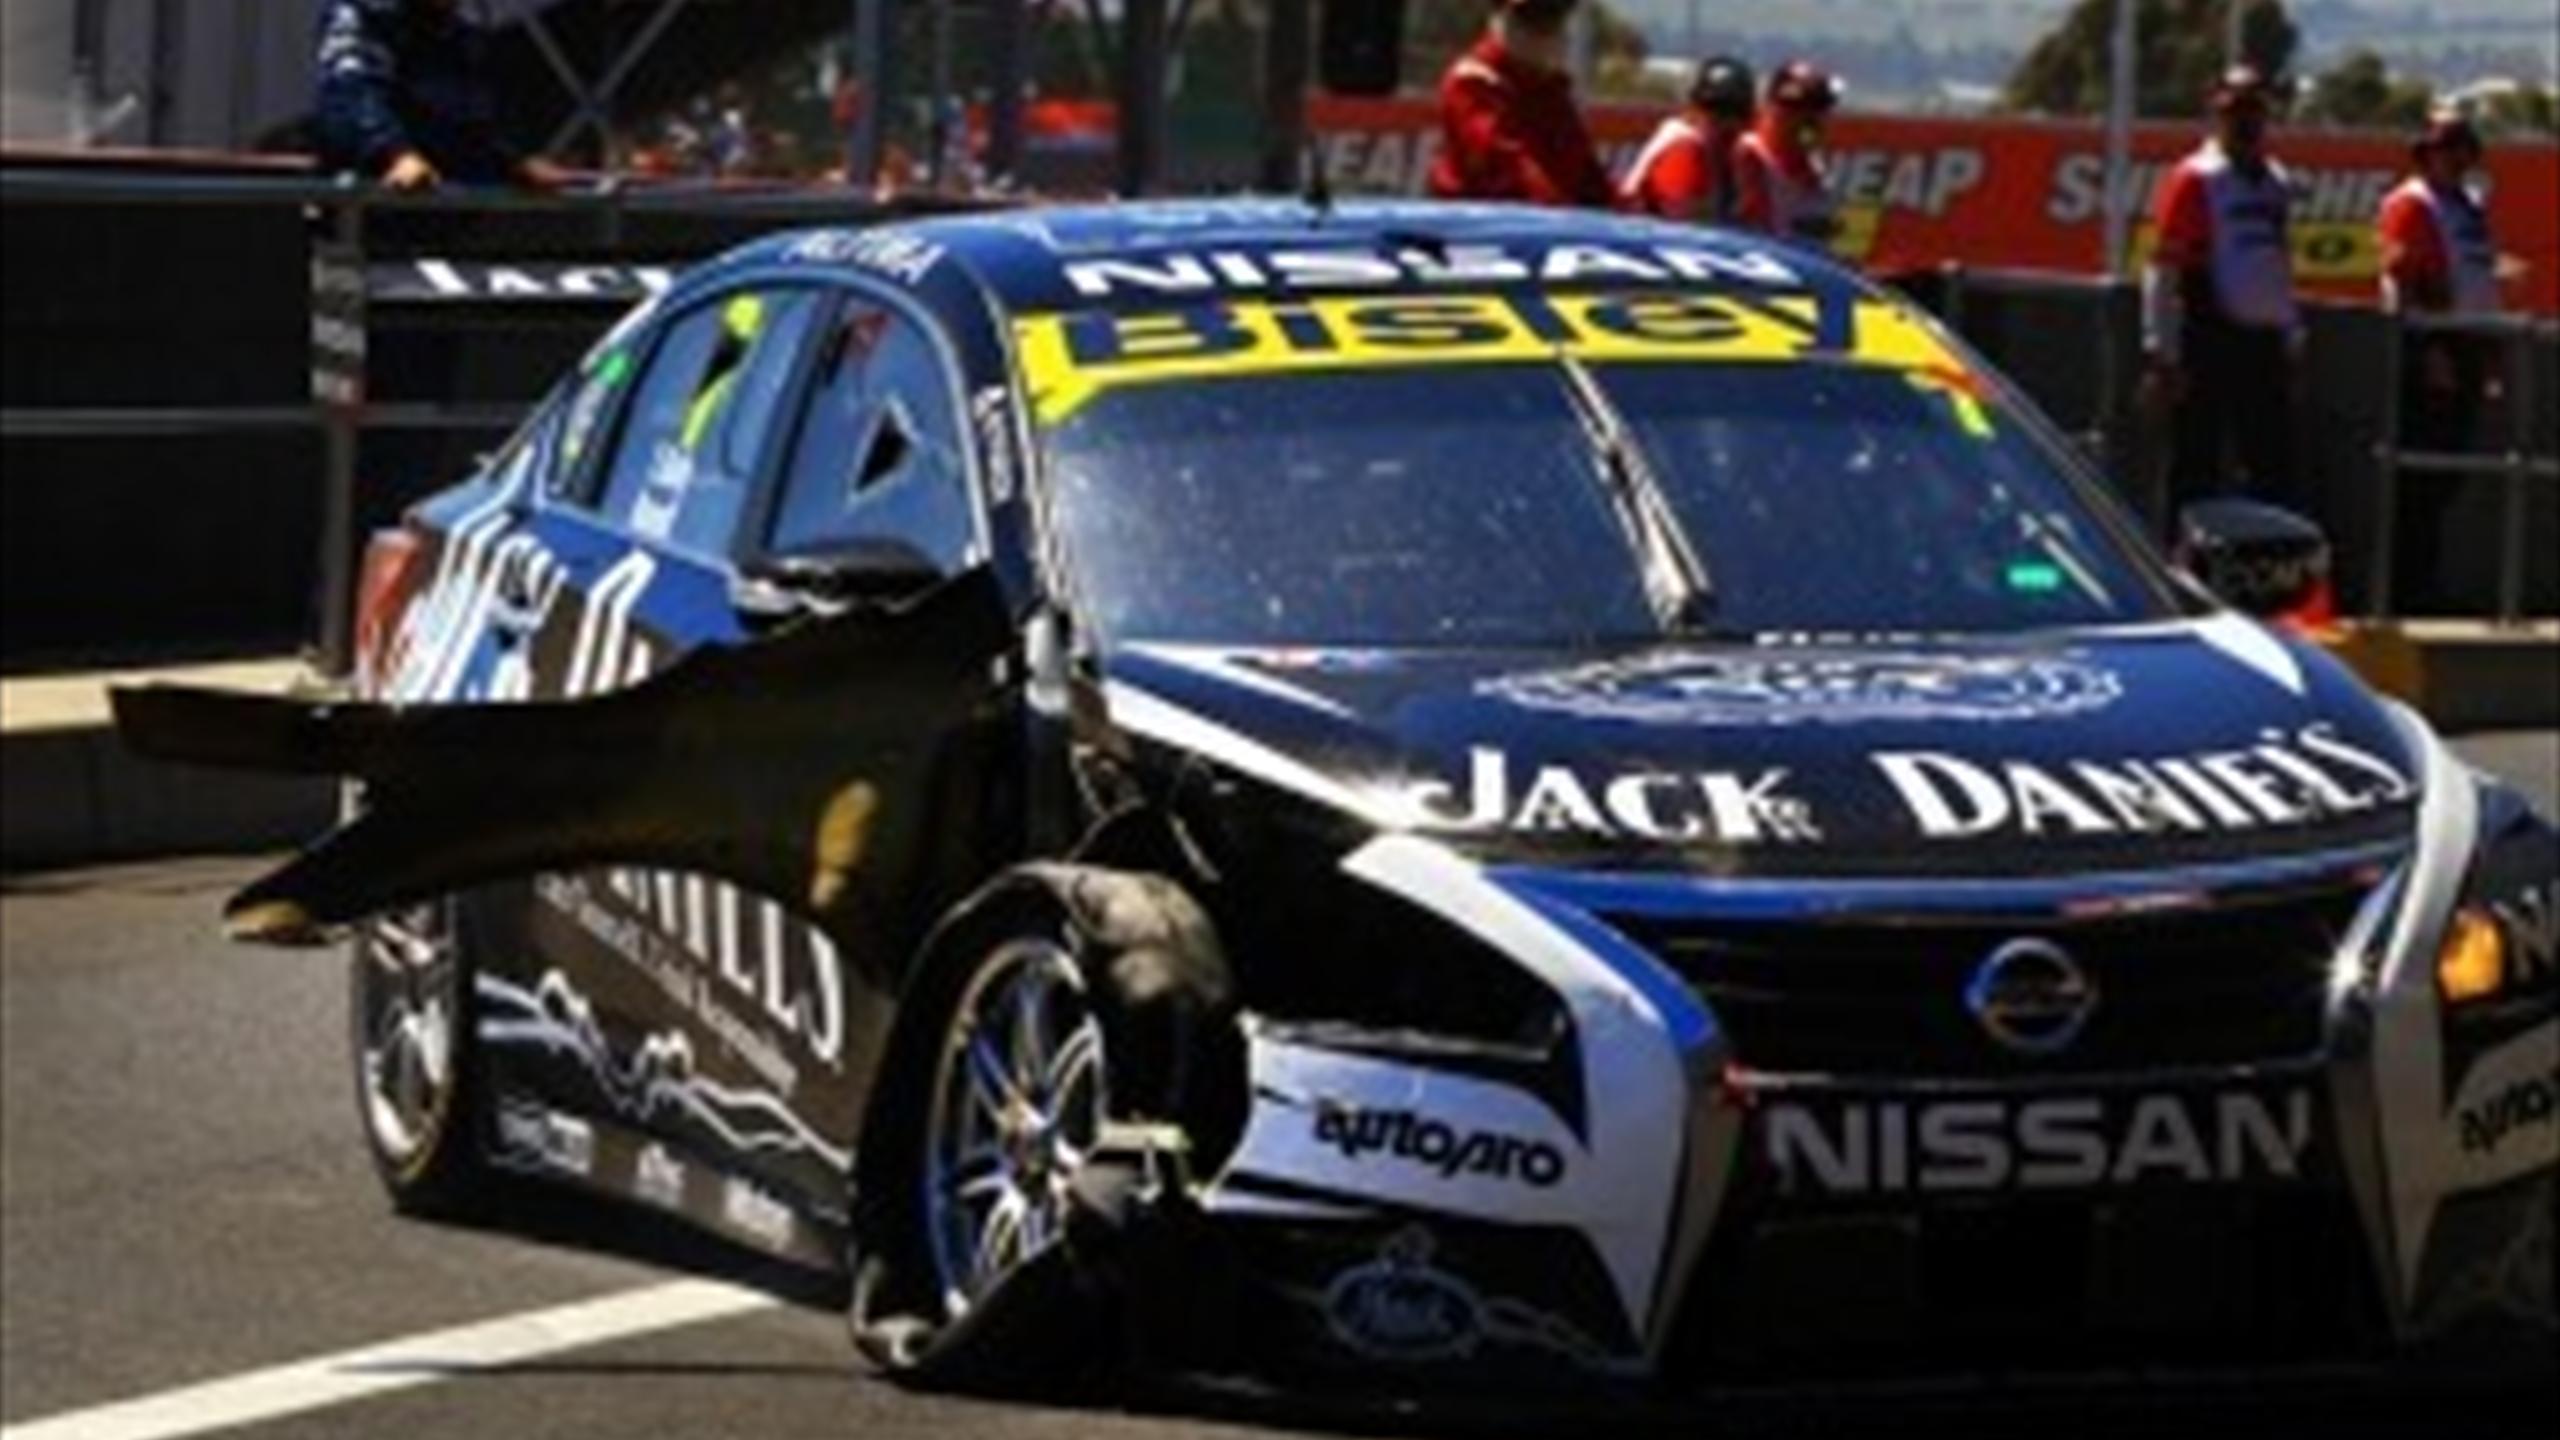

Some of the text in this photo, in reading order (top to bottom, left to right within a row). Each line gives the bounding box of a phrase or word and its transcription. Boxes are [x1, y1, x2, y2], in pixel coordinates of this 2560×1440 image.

[1064, 245, 1800, 295] NISSAN
[1408, 746, 1808, 842] JACK
[1768, 1090, 2310, 1193] NISSAN
